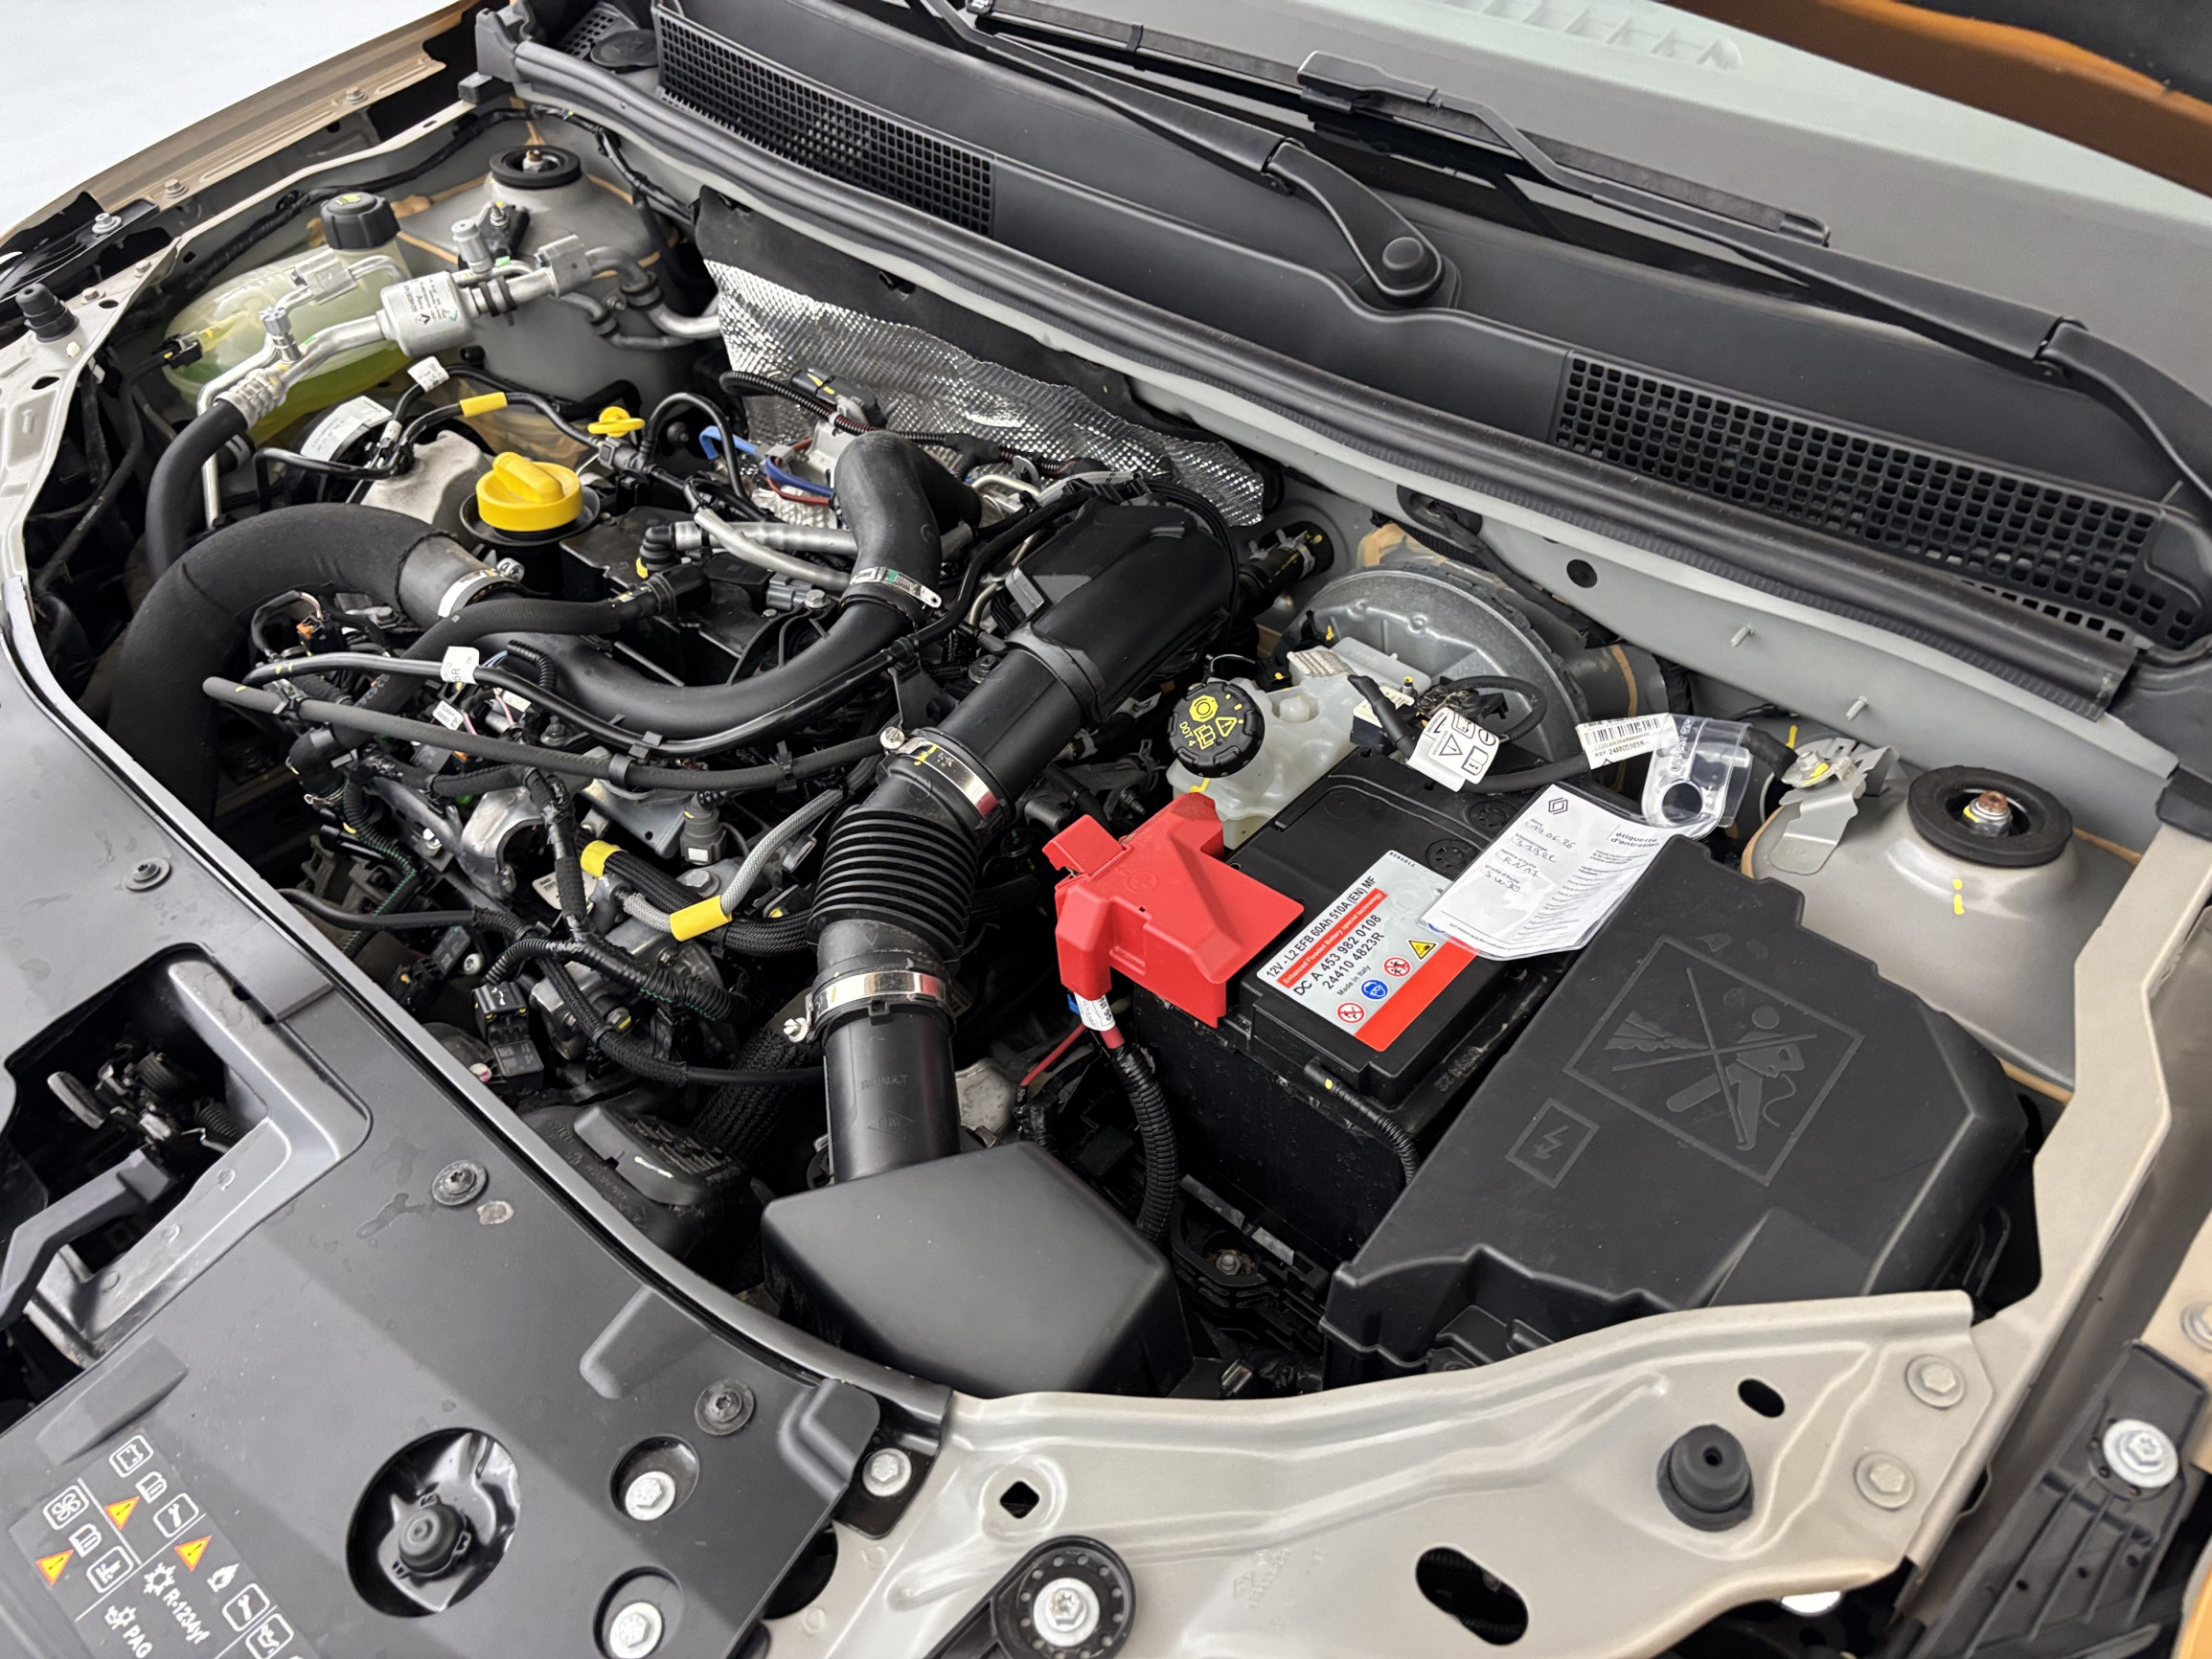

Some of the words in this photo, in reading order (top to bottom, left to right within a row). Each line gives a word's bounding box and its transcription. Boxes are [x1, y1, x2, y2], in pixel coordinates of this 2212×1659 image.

[1179, 721, 1193, 737] DOT
[1266, 962, 1284, 978] 12V
[1284, 948, 1298, 961] L2
[1294, 934, 1314, 952] EFB
[1310, 917, 1333, 937] 60Ah
[1329, 900, 1352, 920] 510A
[1346, 885, 1367, 904] (EN)
[1361, 875, 1376, 889] MF
[1283, 960, 1308, 984] Enhanced
[1306, 943, 1327, 963] Flooded
[1324, 928, 1343, 944] Battery
[1341, 913, 1358, 931] special
[1356, 891, 1381, 915] technology
[1293, 978, 1312, 996] DC
[1312, 970, 1323, 981] A
[1318, 951, 1341, 971] 453
[1337, 935, 1358, 954] 982
[1355, 913, 1381, 937] 0108
[1322, 959, 1354, 989] 24410
[1351, 931, 1384, 962] 4823R
[1336, 980, 1354, 995] Made
[1357, 966, 1371, 978] Italy
